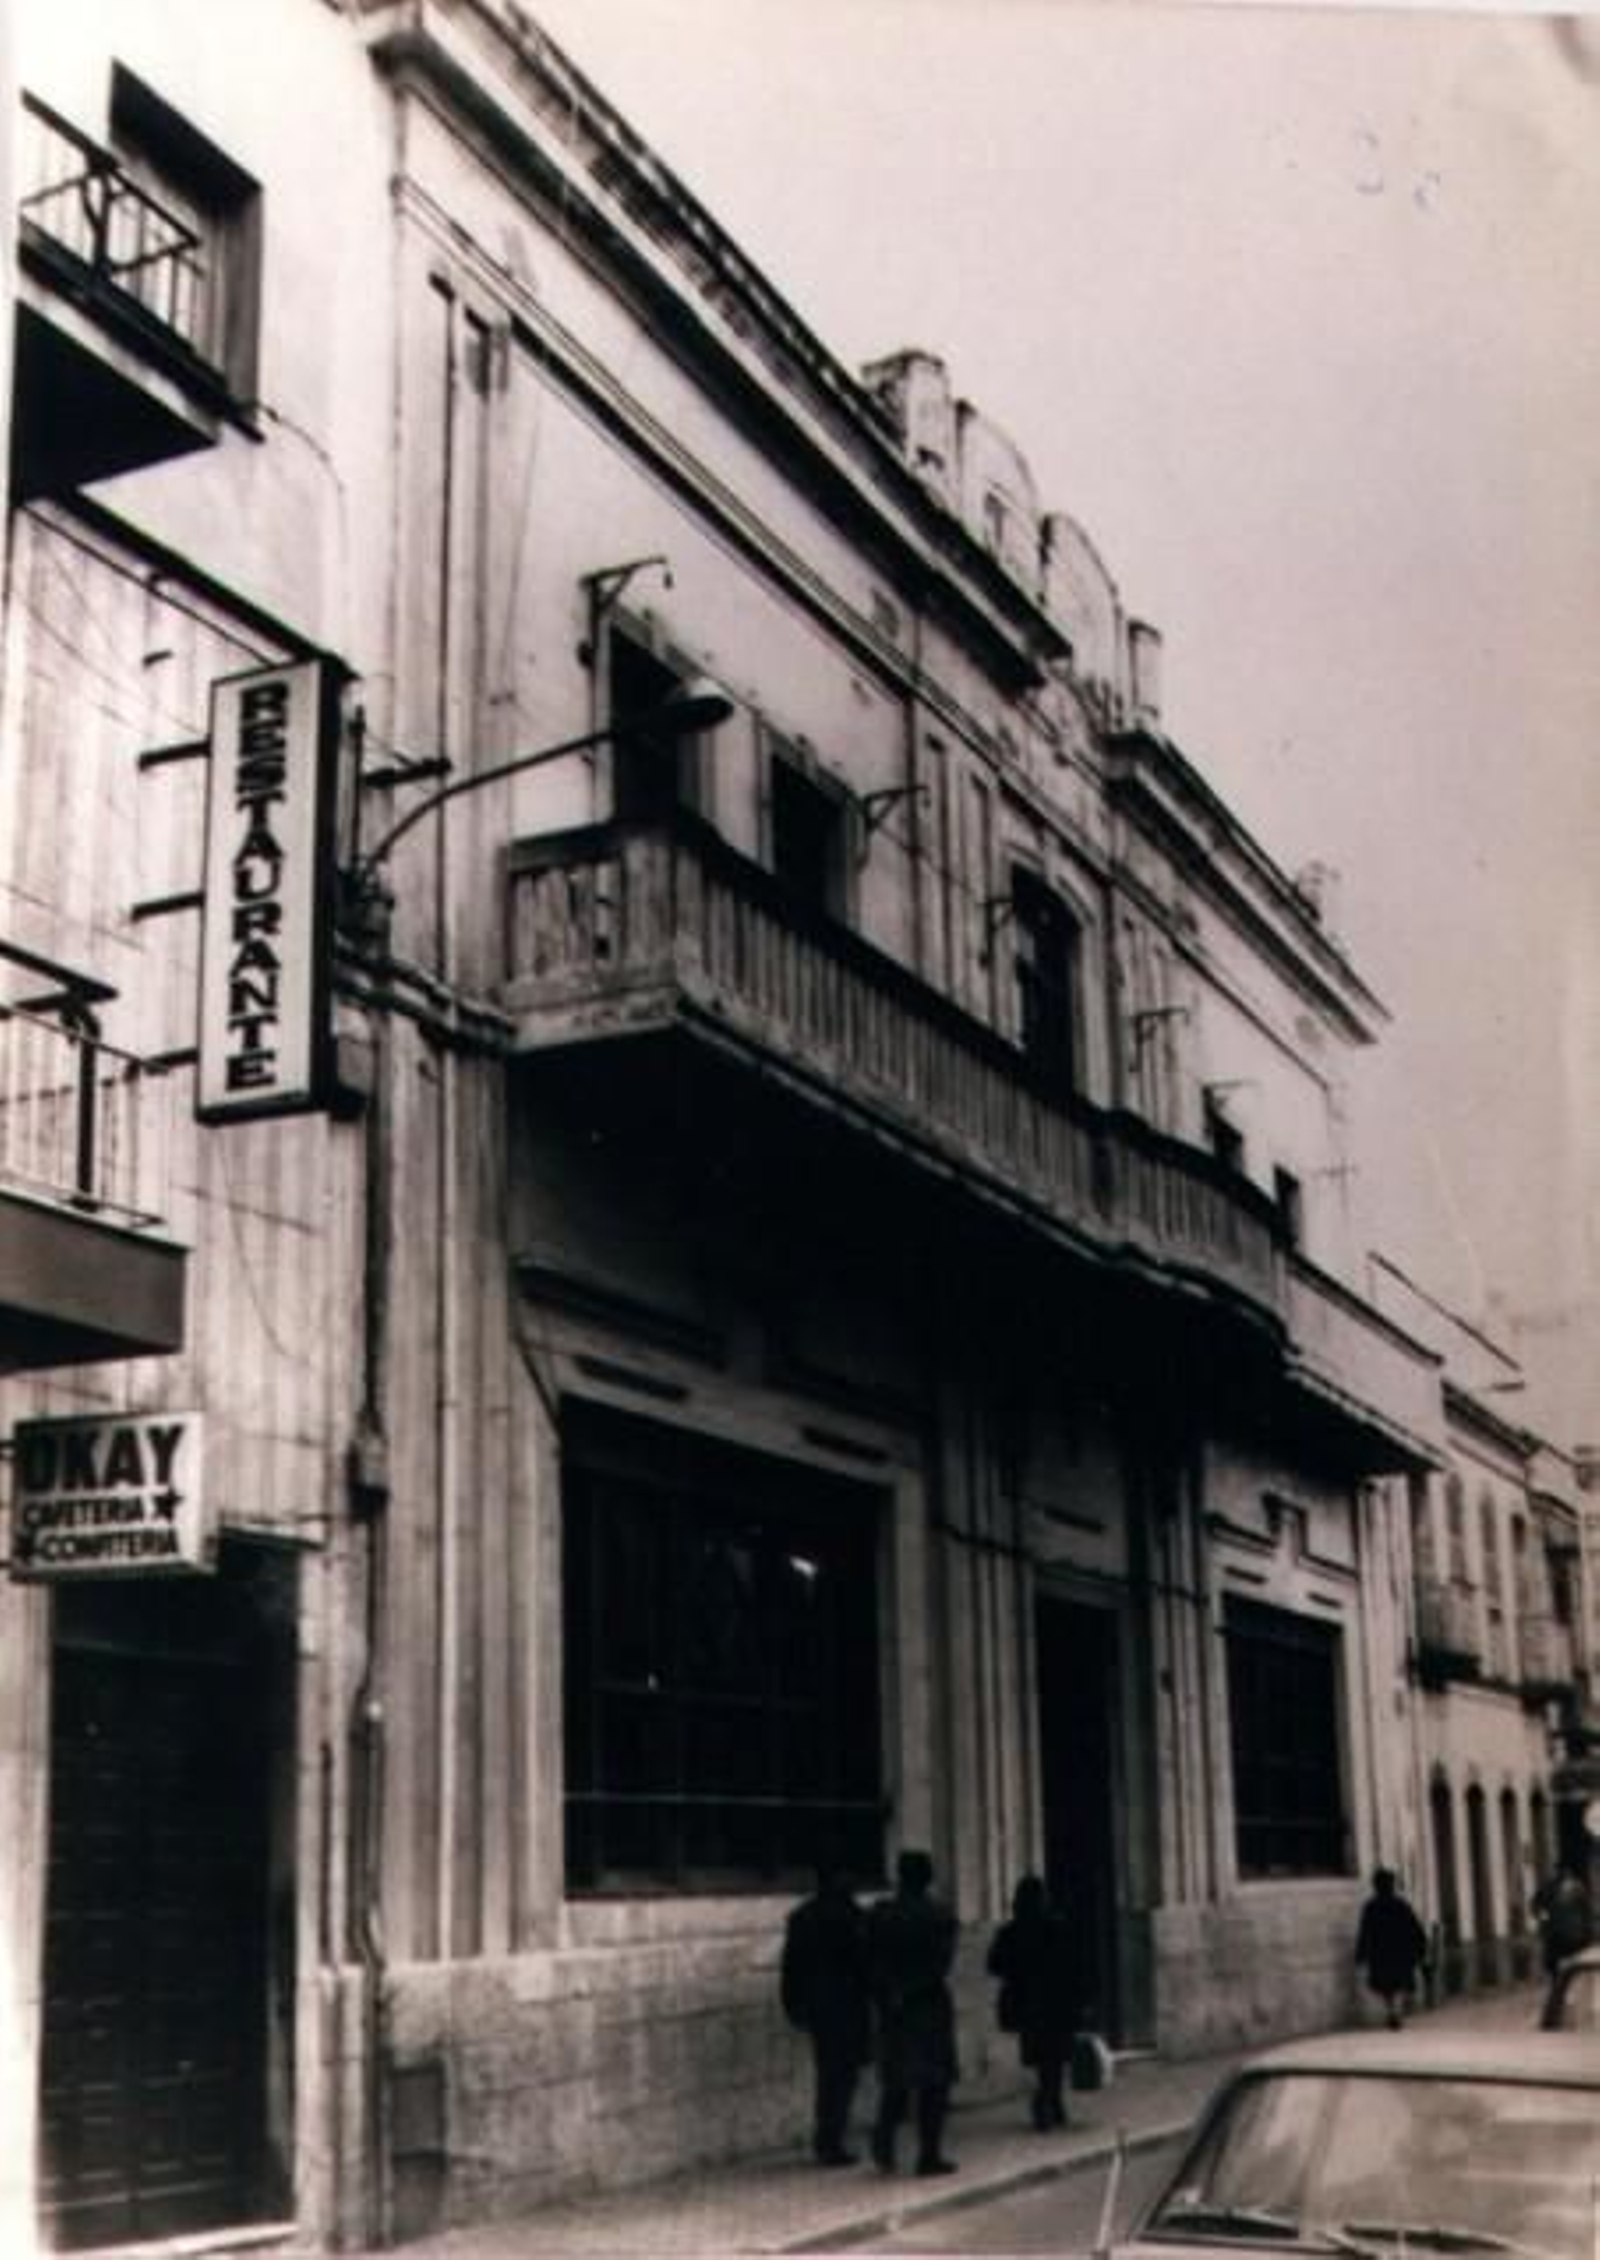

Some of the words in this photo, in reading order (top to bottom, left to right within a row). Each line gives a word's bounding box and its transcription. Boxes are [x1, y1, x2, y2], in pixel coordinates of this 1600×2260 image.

[225, 680, 289, 1092] RESTAURANTE
[20, 1424, 184, 1493] OKAY
[22, 1497, 145, 1528] CAFETERIA
